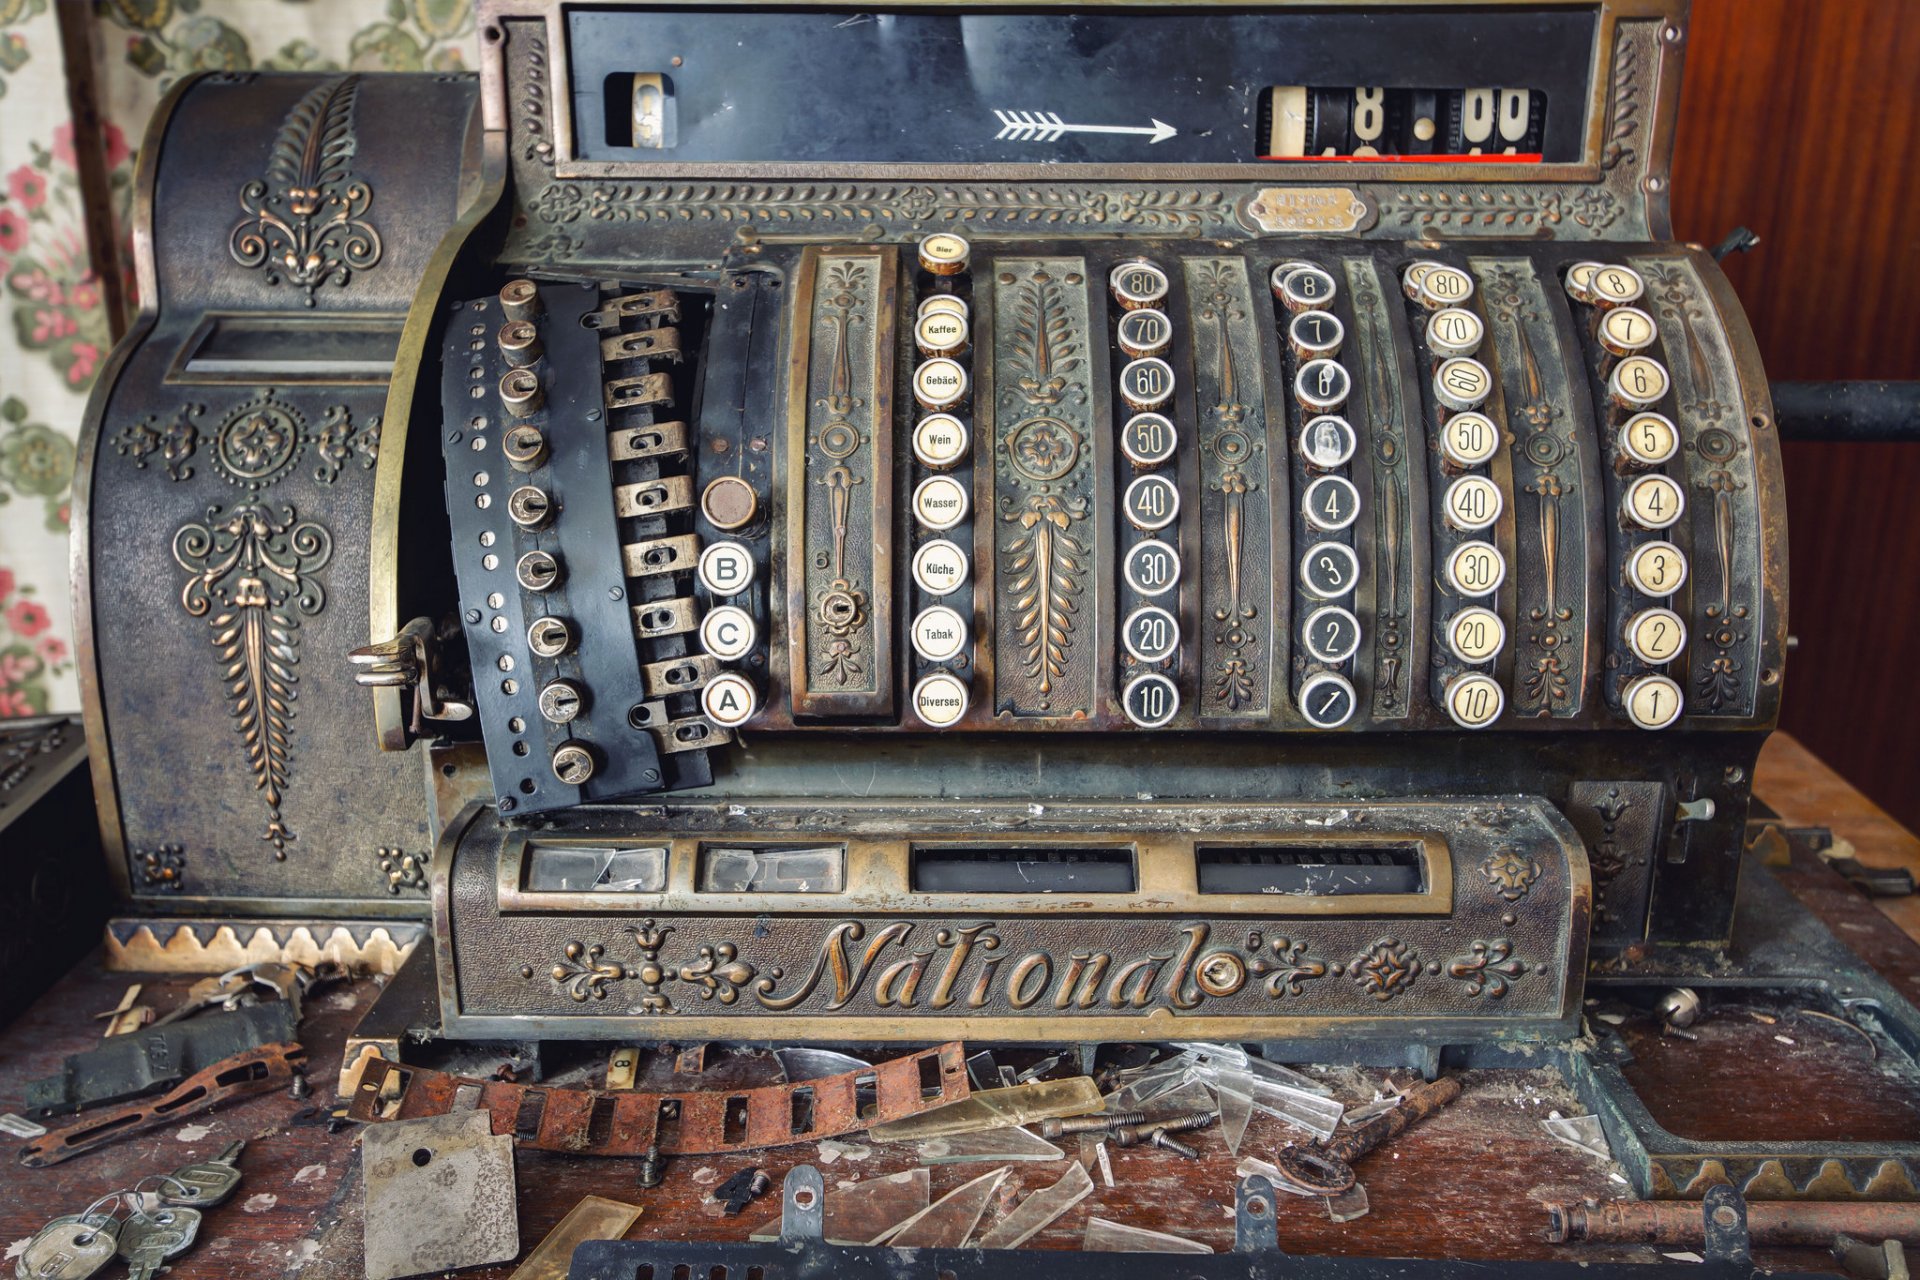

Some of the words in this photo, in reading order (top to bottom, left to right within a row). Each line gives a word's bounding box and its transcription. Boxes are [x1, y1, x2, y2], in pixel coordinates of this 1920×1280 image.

[1131, 274, 1155, 295] 80
[1304, 278, 1315, 297] 8
[1436, 274, 1462, 296] 80
[1610, 274, 1626, 295] 8
[928, 325, 957, 334] Kaffee
[1134, 318, 1160, 342] 70
[1308, 319, 1322, 343] 7
[1439, 314, 1469, 343] 70
[1620, 318, 1633, 341] 7
[926, 375, 959, 386] Gebäck
[1136, 368, 1163, 397] 60
[1447, 367, 1481, 394] 60
[1633, 366, 1647, 394] 6
[928, 434, 951, 445] Wein
[1137, 424, 1163, 454] 50
[1458, 420, 1484, 452] 50
[1643, 424, 1656, 453] 5
[923, 497, 958, 508] Wasser
[1137, 485, 1165, 517] 40
[1324, 489, 1340, 520] 4
[1458, 487, 1486, 519] 40
[1647, 487, 1664, 517] 4
[716, 557, 738, 581] B
[926, 563, 954, 575] Küche
[1141, 553, 1167, 585] 30
[1320, 556, 1342, 585] 3
[1464, 555, 1490, 585] 30
[1652, 555, 1665, 586] 3
[717, 622, 739, 646] C
[925, 628, 953, 640] Tabak
[1140, 619, 1165, 652] 20
[1325, 621, 1340, 652] 2
[1460, 620, 1485, 652] 20
[1651, 621, 1666, 652] 2
[718, 689, 740, 711] A
[920, 696, 961, 708] Diverses
[1140, 686, 1164, 718] 10
[1318, 690, 1342, 716] 1
[1463, 687, 1490, 721] 10
[1651, 689, 1659, 719] 1
[755, 920, 1212, 1010] National
